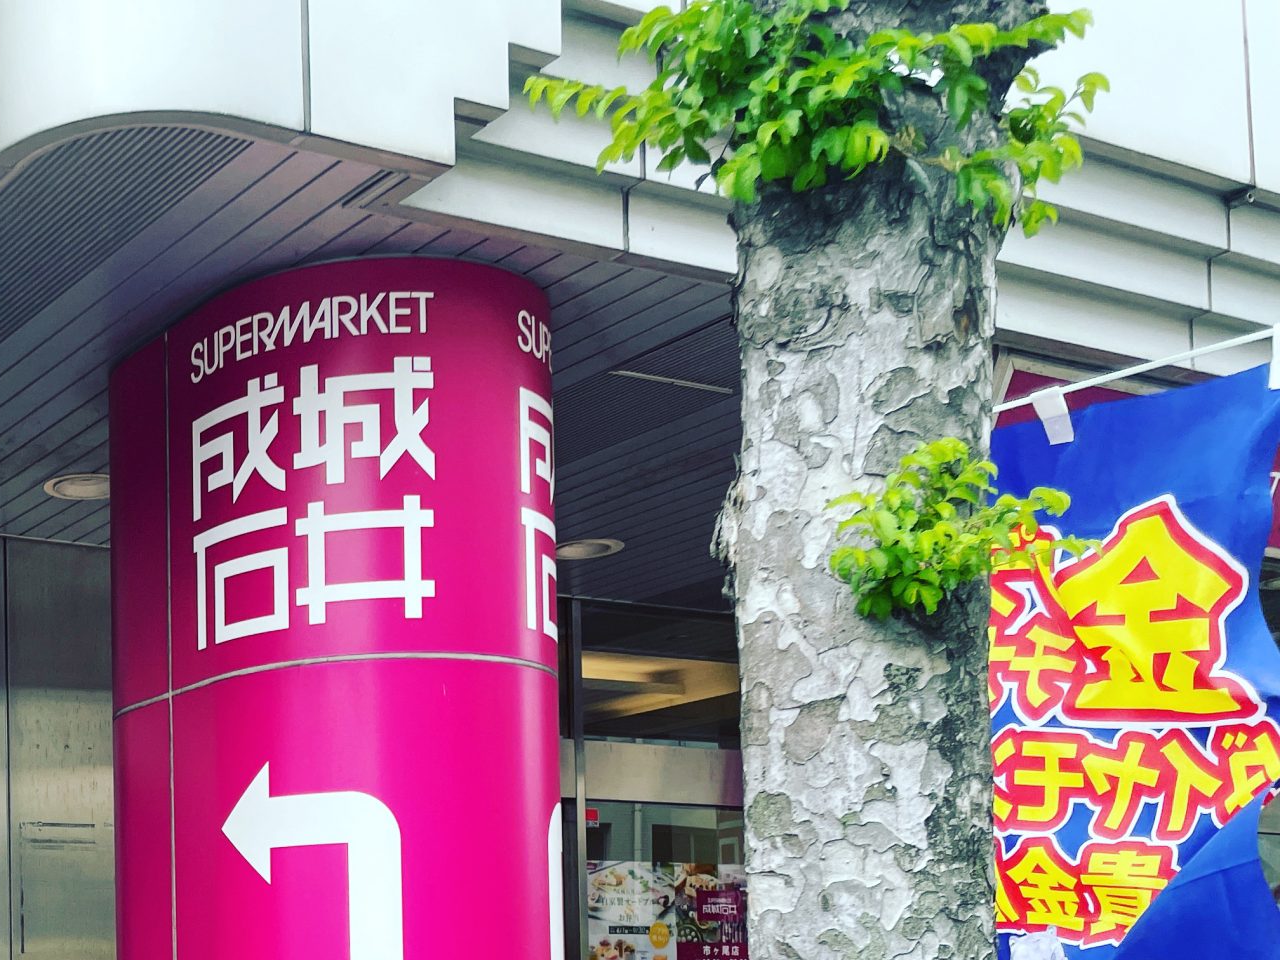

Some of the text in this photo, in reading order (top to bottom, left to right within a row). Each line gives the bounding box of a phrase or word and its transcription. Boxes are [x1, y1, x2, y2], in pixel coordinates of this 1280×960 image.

[190, 291, 434, 384] SUPERMARKET
[192, 356, 436, 522] 成城
[192, 494, 436, 651] 石井
